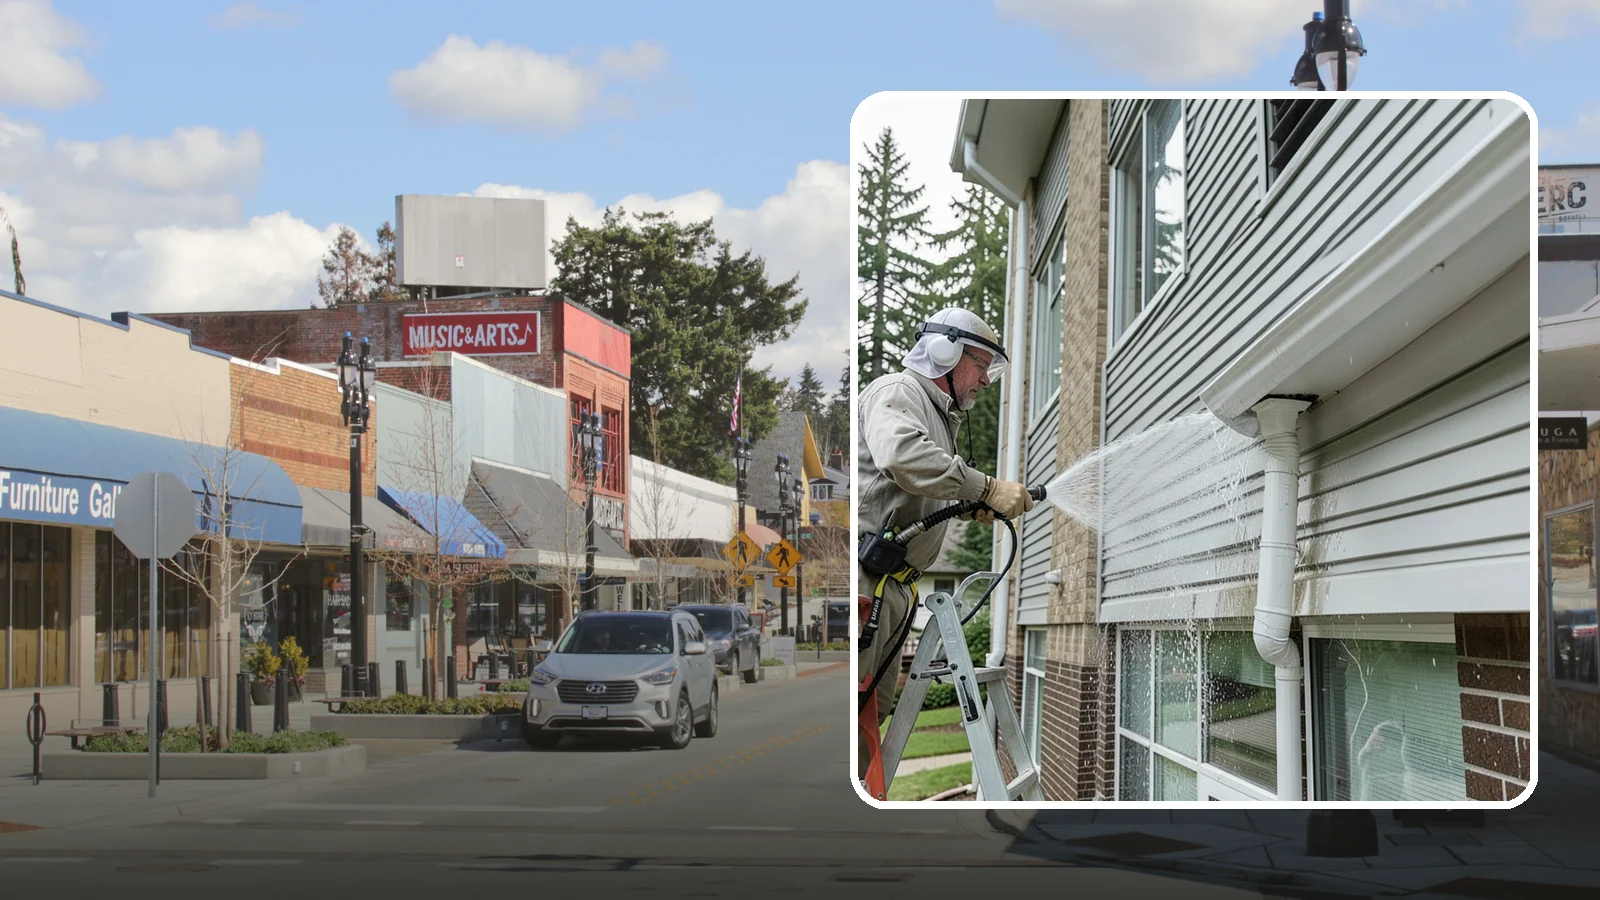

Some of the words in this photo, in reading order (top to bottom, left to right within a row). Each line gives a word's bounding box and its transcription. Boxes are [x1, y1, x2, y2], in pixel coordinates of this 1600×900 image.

[408, 322, 520, 349] MUSIC&ARTS
[1540, 427, 1578, 437] UGA
[0, 471, 79, 516] Furniture
[89, 482, 122, 519] Gal
[453, 563, 480, 574] SUSHI
